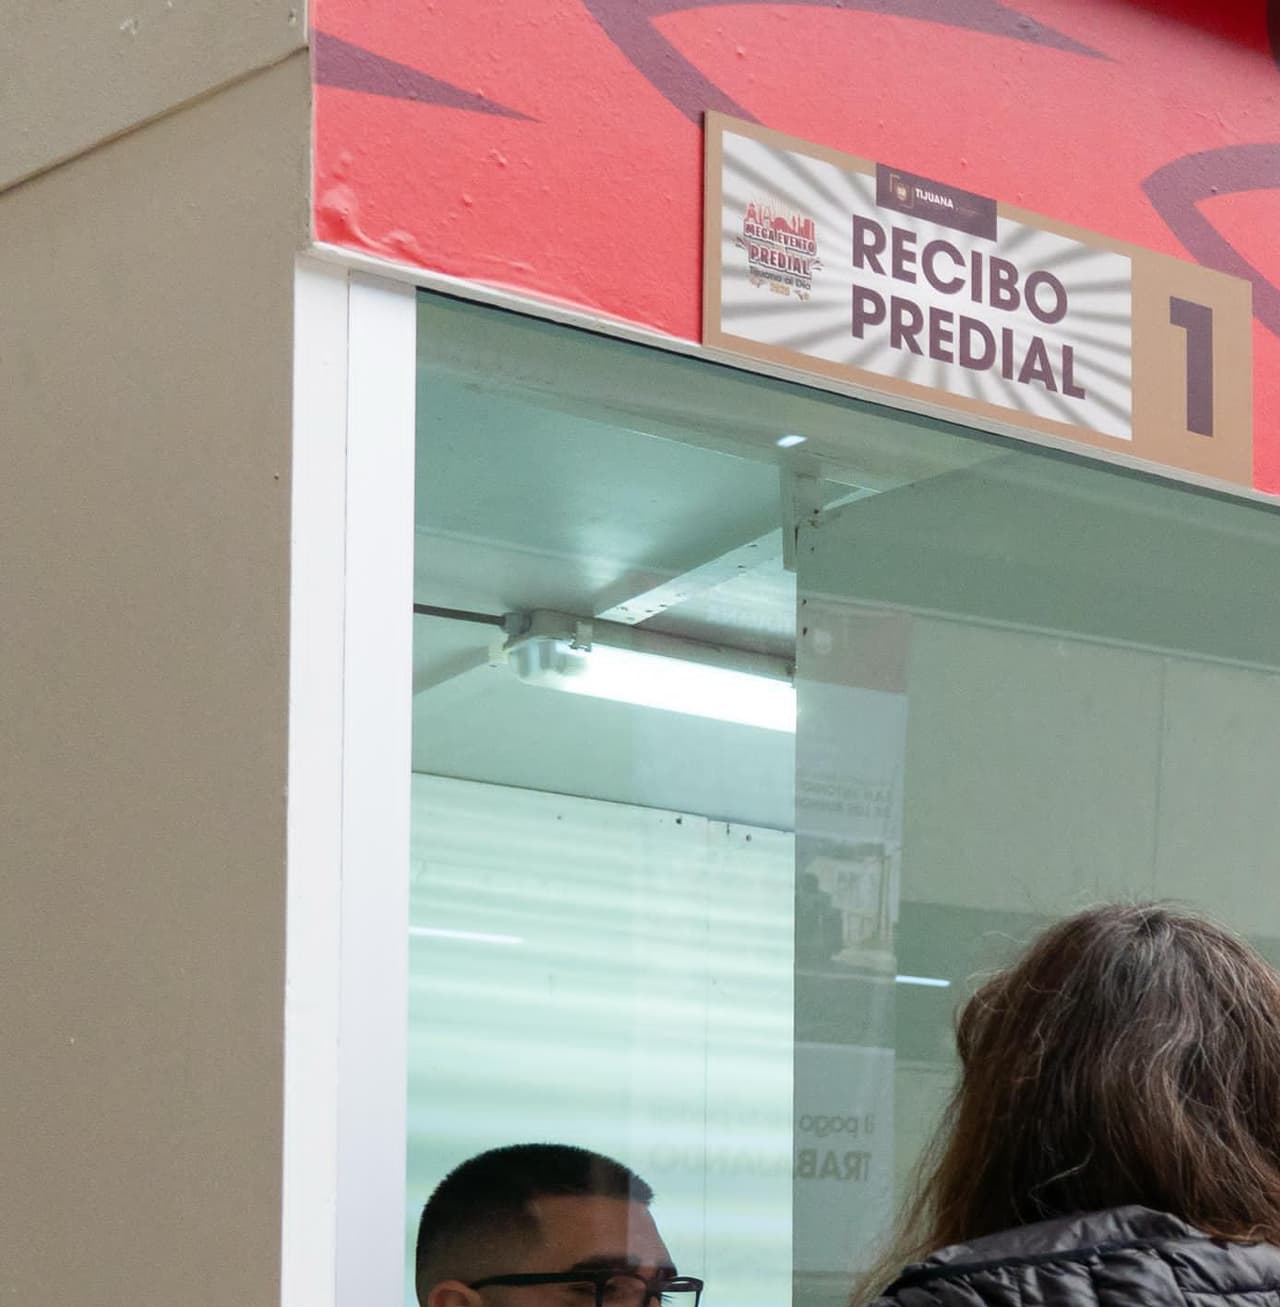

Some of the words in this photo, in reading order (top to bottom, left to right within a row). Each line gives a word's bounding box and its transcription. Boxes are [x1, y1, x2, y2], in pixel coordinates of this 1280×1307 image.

[745, 222, 775, 241] MEGA
[915, 188, 954, 209] TIJUANA
[751, 245, 810, 276] PREDIAL
[852, 214, 1069, 325] RECIBO
[851, 285, 1086, 400] PREDIAL
[1169, 295, 1214, 438] 1
